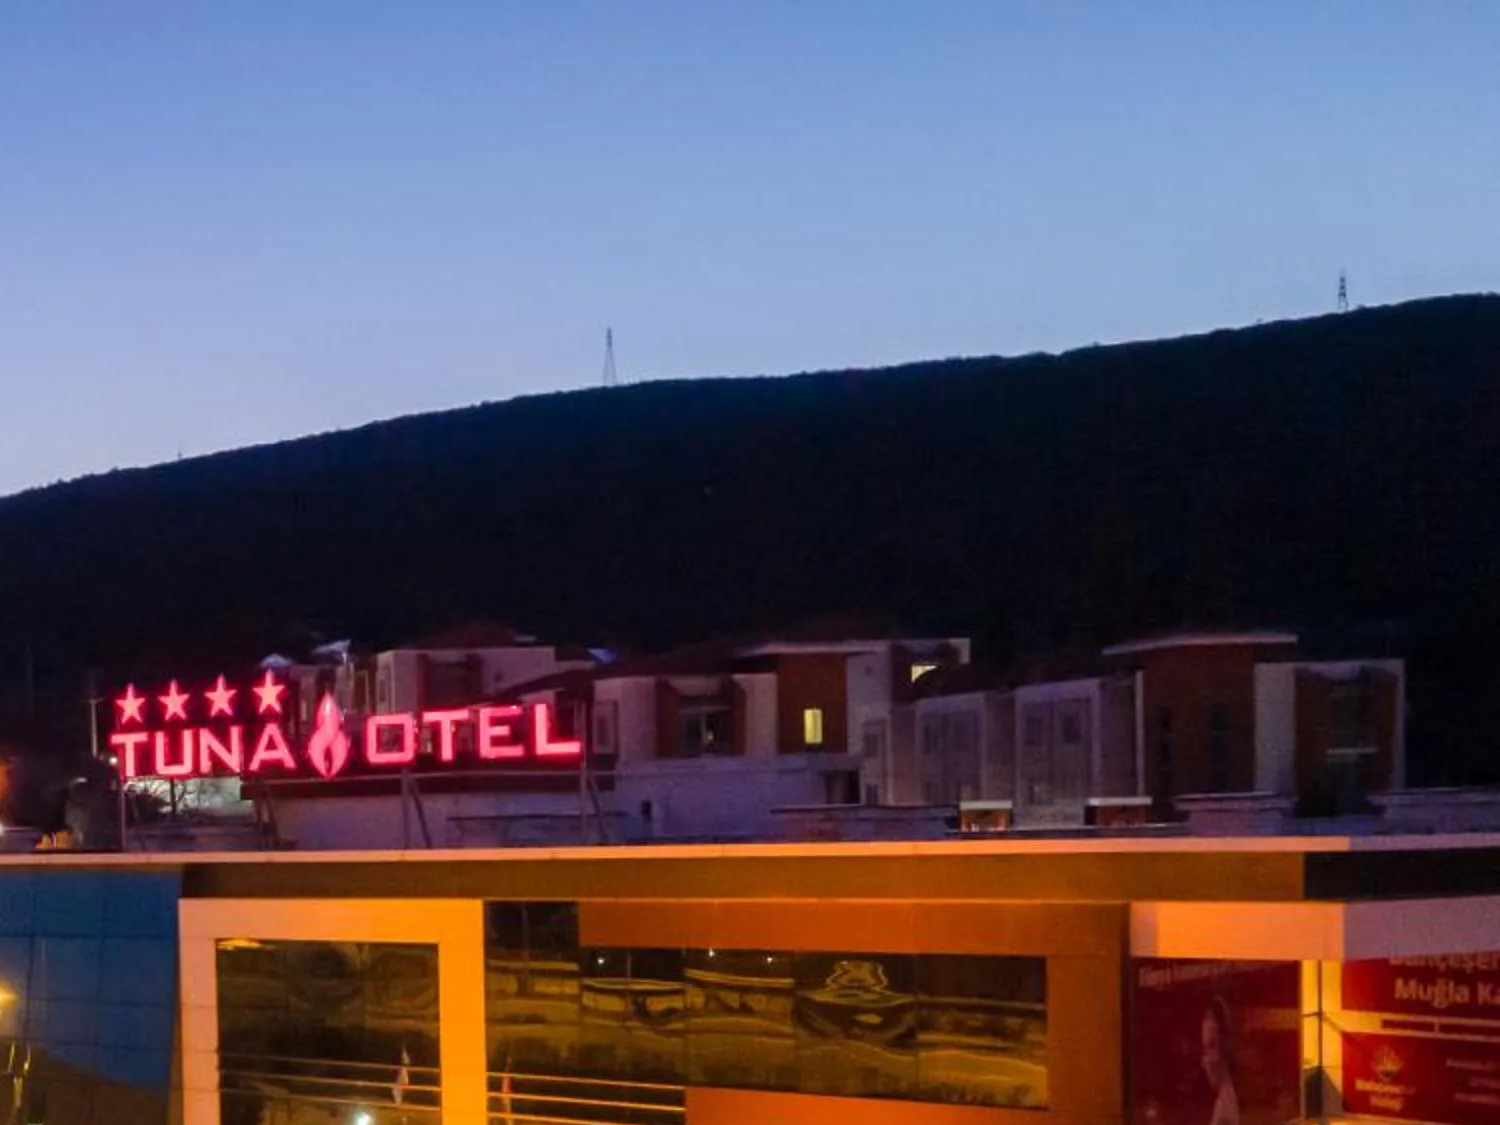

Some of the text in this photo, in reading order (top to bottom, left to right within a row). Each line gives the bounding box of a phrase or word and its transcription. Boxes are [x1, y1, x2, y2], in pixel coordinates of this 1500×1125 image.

[110, 703, 582, 779] TUNA OTEL
[1394, 977, 1470, 1009] Muğla
